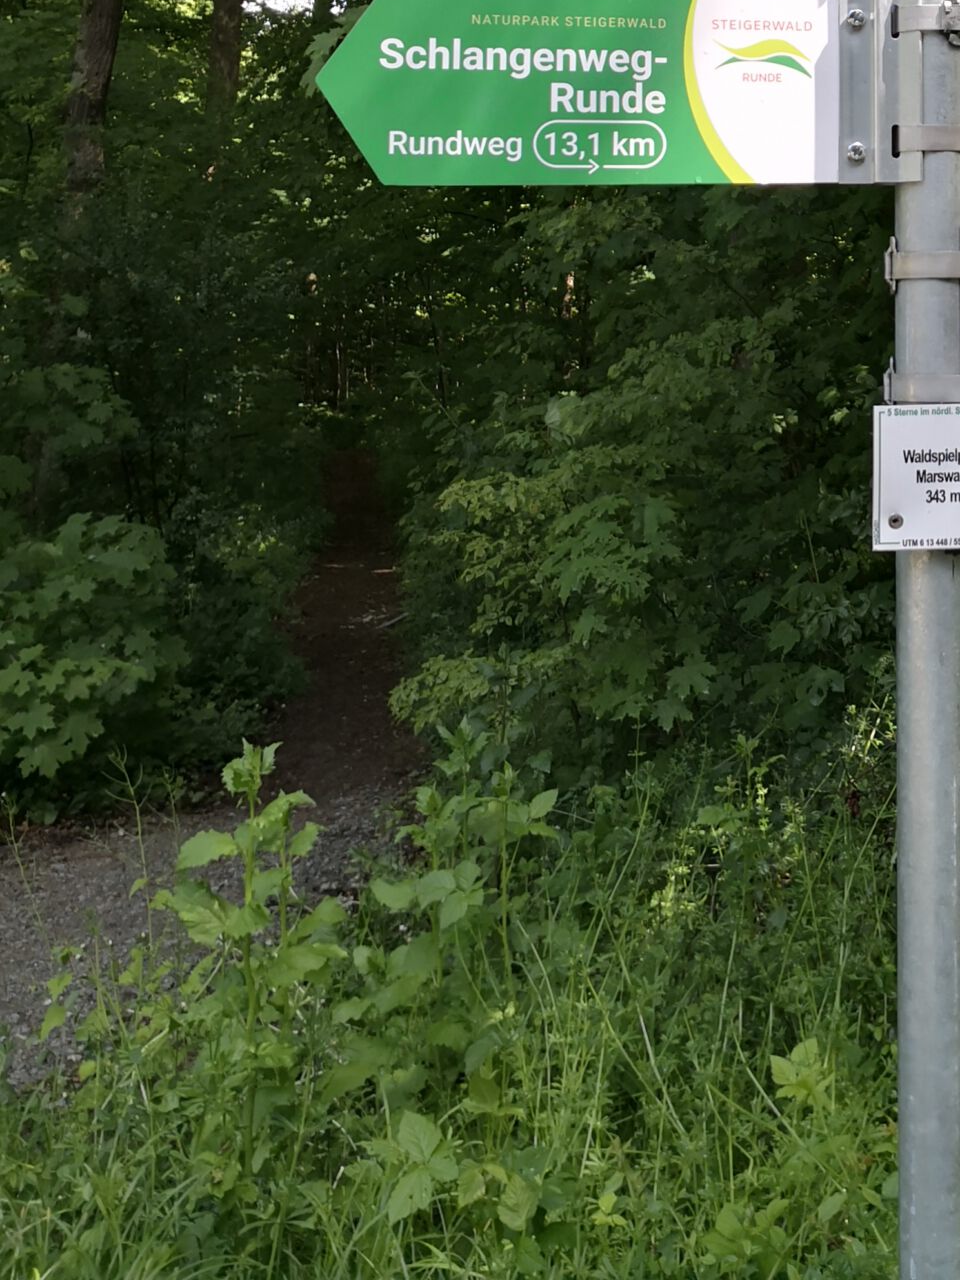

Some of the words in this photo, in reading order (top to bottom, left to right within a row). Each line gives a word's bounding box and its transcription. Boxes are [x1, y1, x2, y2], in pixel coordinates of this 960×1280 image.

[471, 14, 559, 27] NATURPARK
[565, 16, 667, 30] STEIGERWALD
[712, 19, 812, 32] STEIGERWALD
[380, 38, 667, 79] Schlangenweg-
[742, 73, 782, 82] RUNDE
[550, 83, 666, 113] Runde
[389, 131, 523, 161] Rundweg
[544, 132, 600, 161] 13,1
[612, 133, 655, 156] km
[932, 407, 953, 415] nördl.
[926, 490, 946, 503] 343
[950, 492, 960, 502] m
